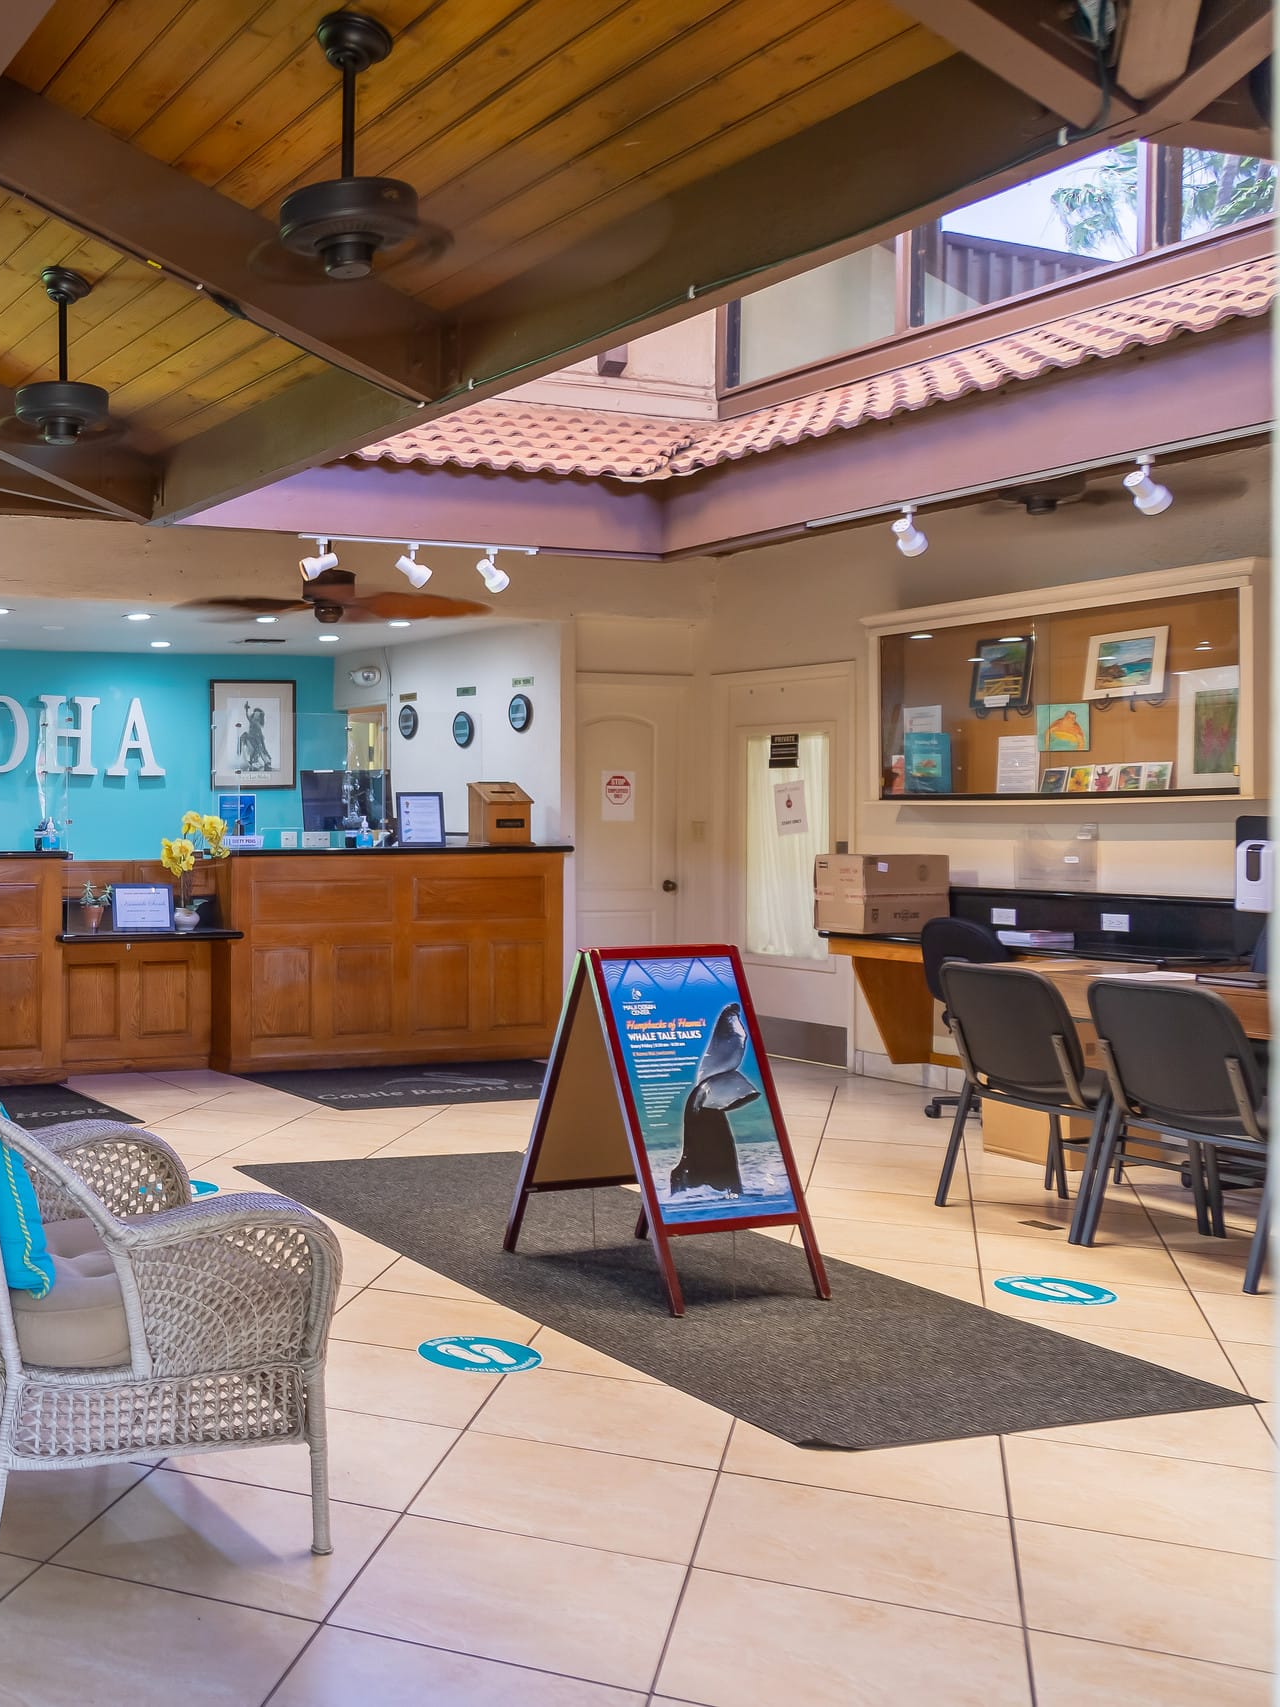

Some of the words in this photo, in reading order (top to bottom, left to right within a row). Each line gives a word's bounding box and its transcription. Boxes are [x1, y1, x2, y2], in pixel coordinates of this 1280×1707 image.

[626, 1019, 667, 1032] Humpbacks
[667, 1018, 676, 1031] of
[627, 1032, 656, 1041] WHALE
[657, 1031, 677, 1040] TALE
[677, 1030, 702, 1039] TALKS
[317, 1089, 405, 1101] Castle
[411, 1084, 509, 1096] Resorts
[16, 1106, 111, 1119] Hotels
